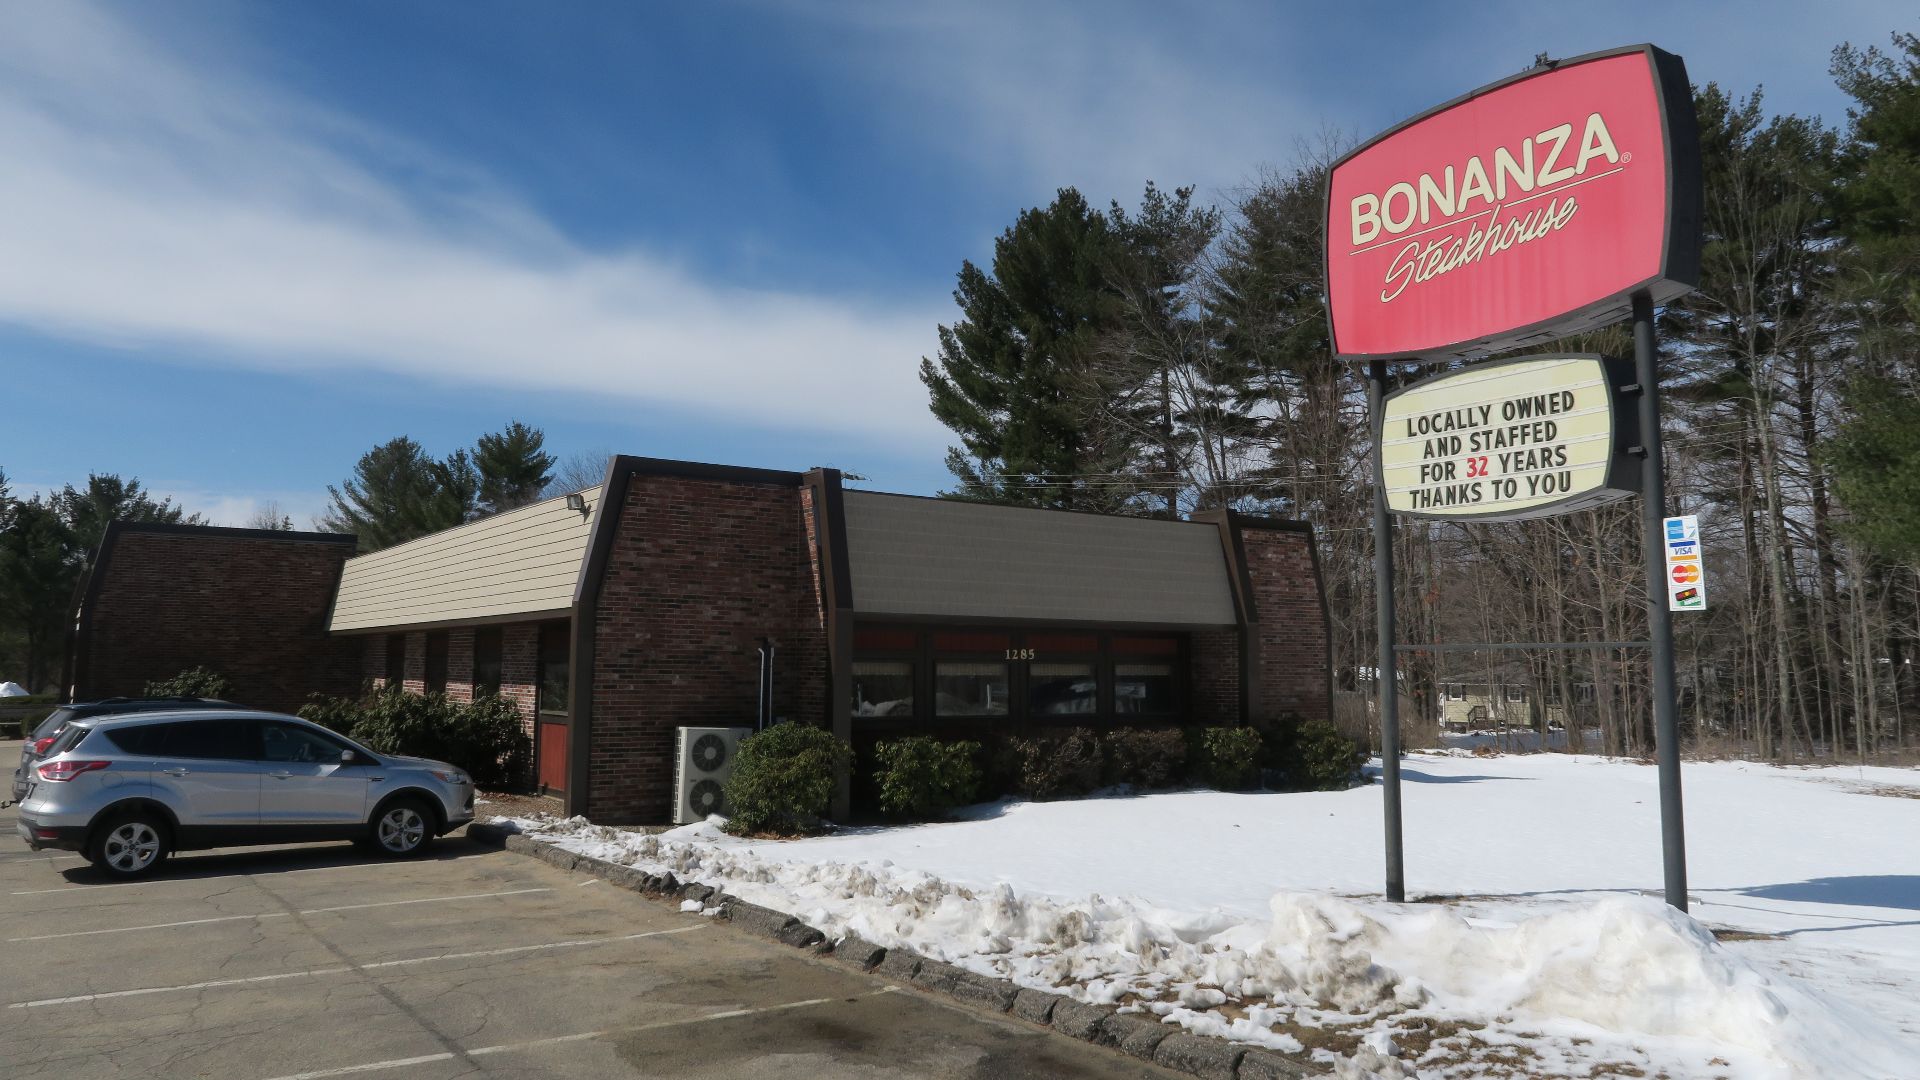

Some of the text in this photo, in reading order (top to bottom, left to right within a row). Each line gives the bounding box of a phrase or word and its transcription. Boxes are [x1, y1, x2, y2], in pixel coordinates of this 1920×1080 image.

[1350, 112, 1619, 246] BONANZA
[1380, 196, 1579, 304] Steakhouse
[1407, 390, 1574, 437] LOCALLY OWNED
[1423, 420, 1557, 460] AND STAFFED
[1420, 445, 1567, 484] FOR 32 YEARS
[1409, 470, 1571, 509] THANKS TO YOU
[1674, 546, 1692, 555] VISA
[1005, 648, 1035, 660] 1285
